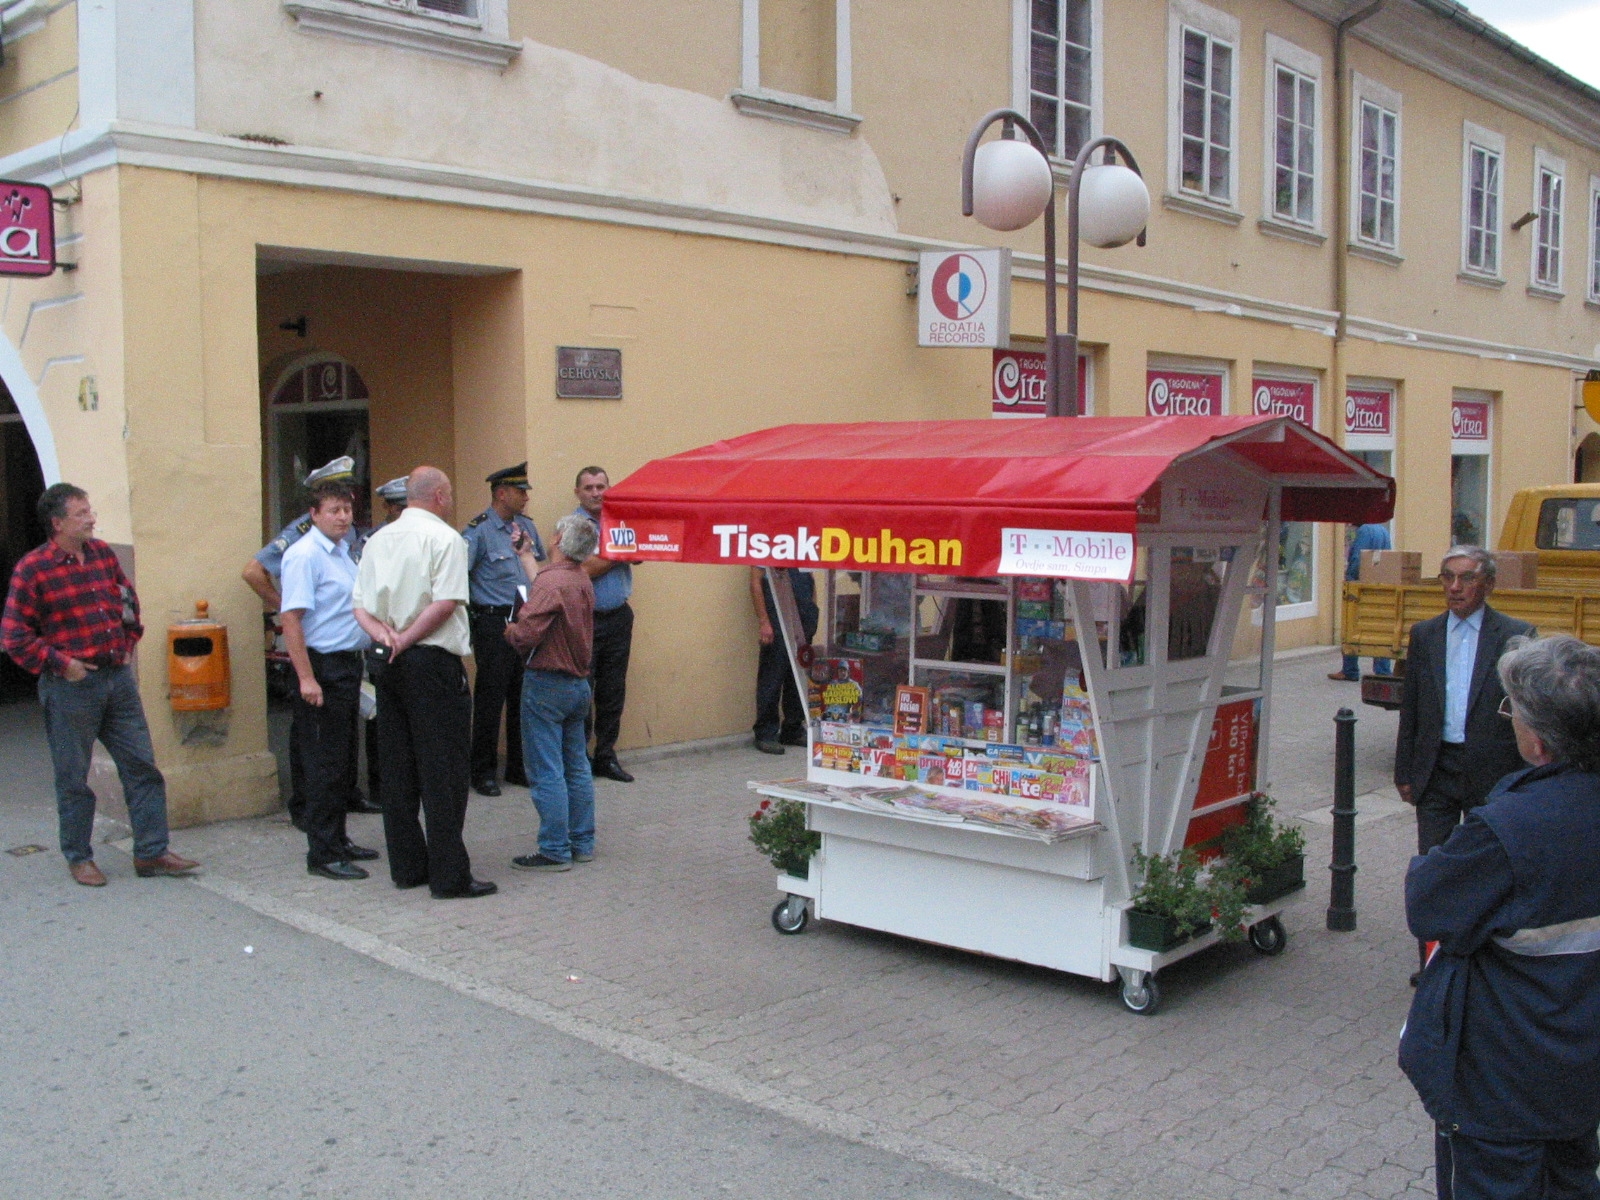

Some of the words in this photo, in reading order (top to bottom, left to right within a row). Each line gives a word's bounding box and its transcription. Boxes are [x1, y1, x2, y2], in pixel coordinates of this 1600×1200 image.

[929, 321, 986, 333] CROATIA
[929, 332, 986, 343] RECORDS
[648, 533, 669, 542] SNAGA
[1015, 558, 1045, 571] Ovdje
[1074, 561, 1108, 576] Simpa
